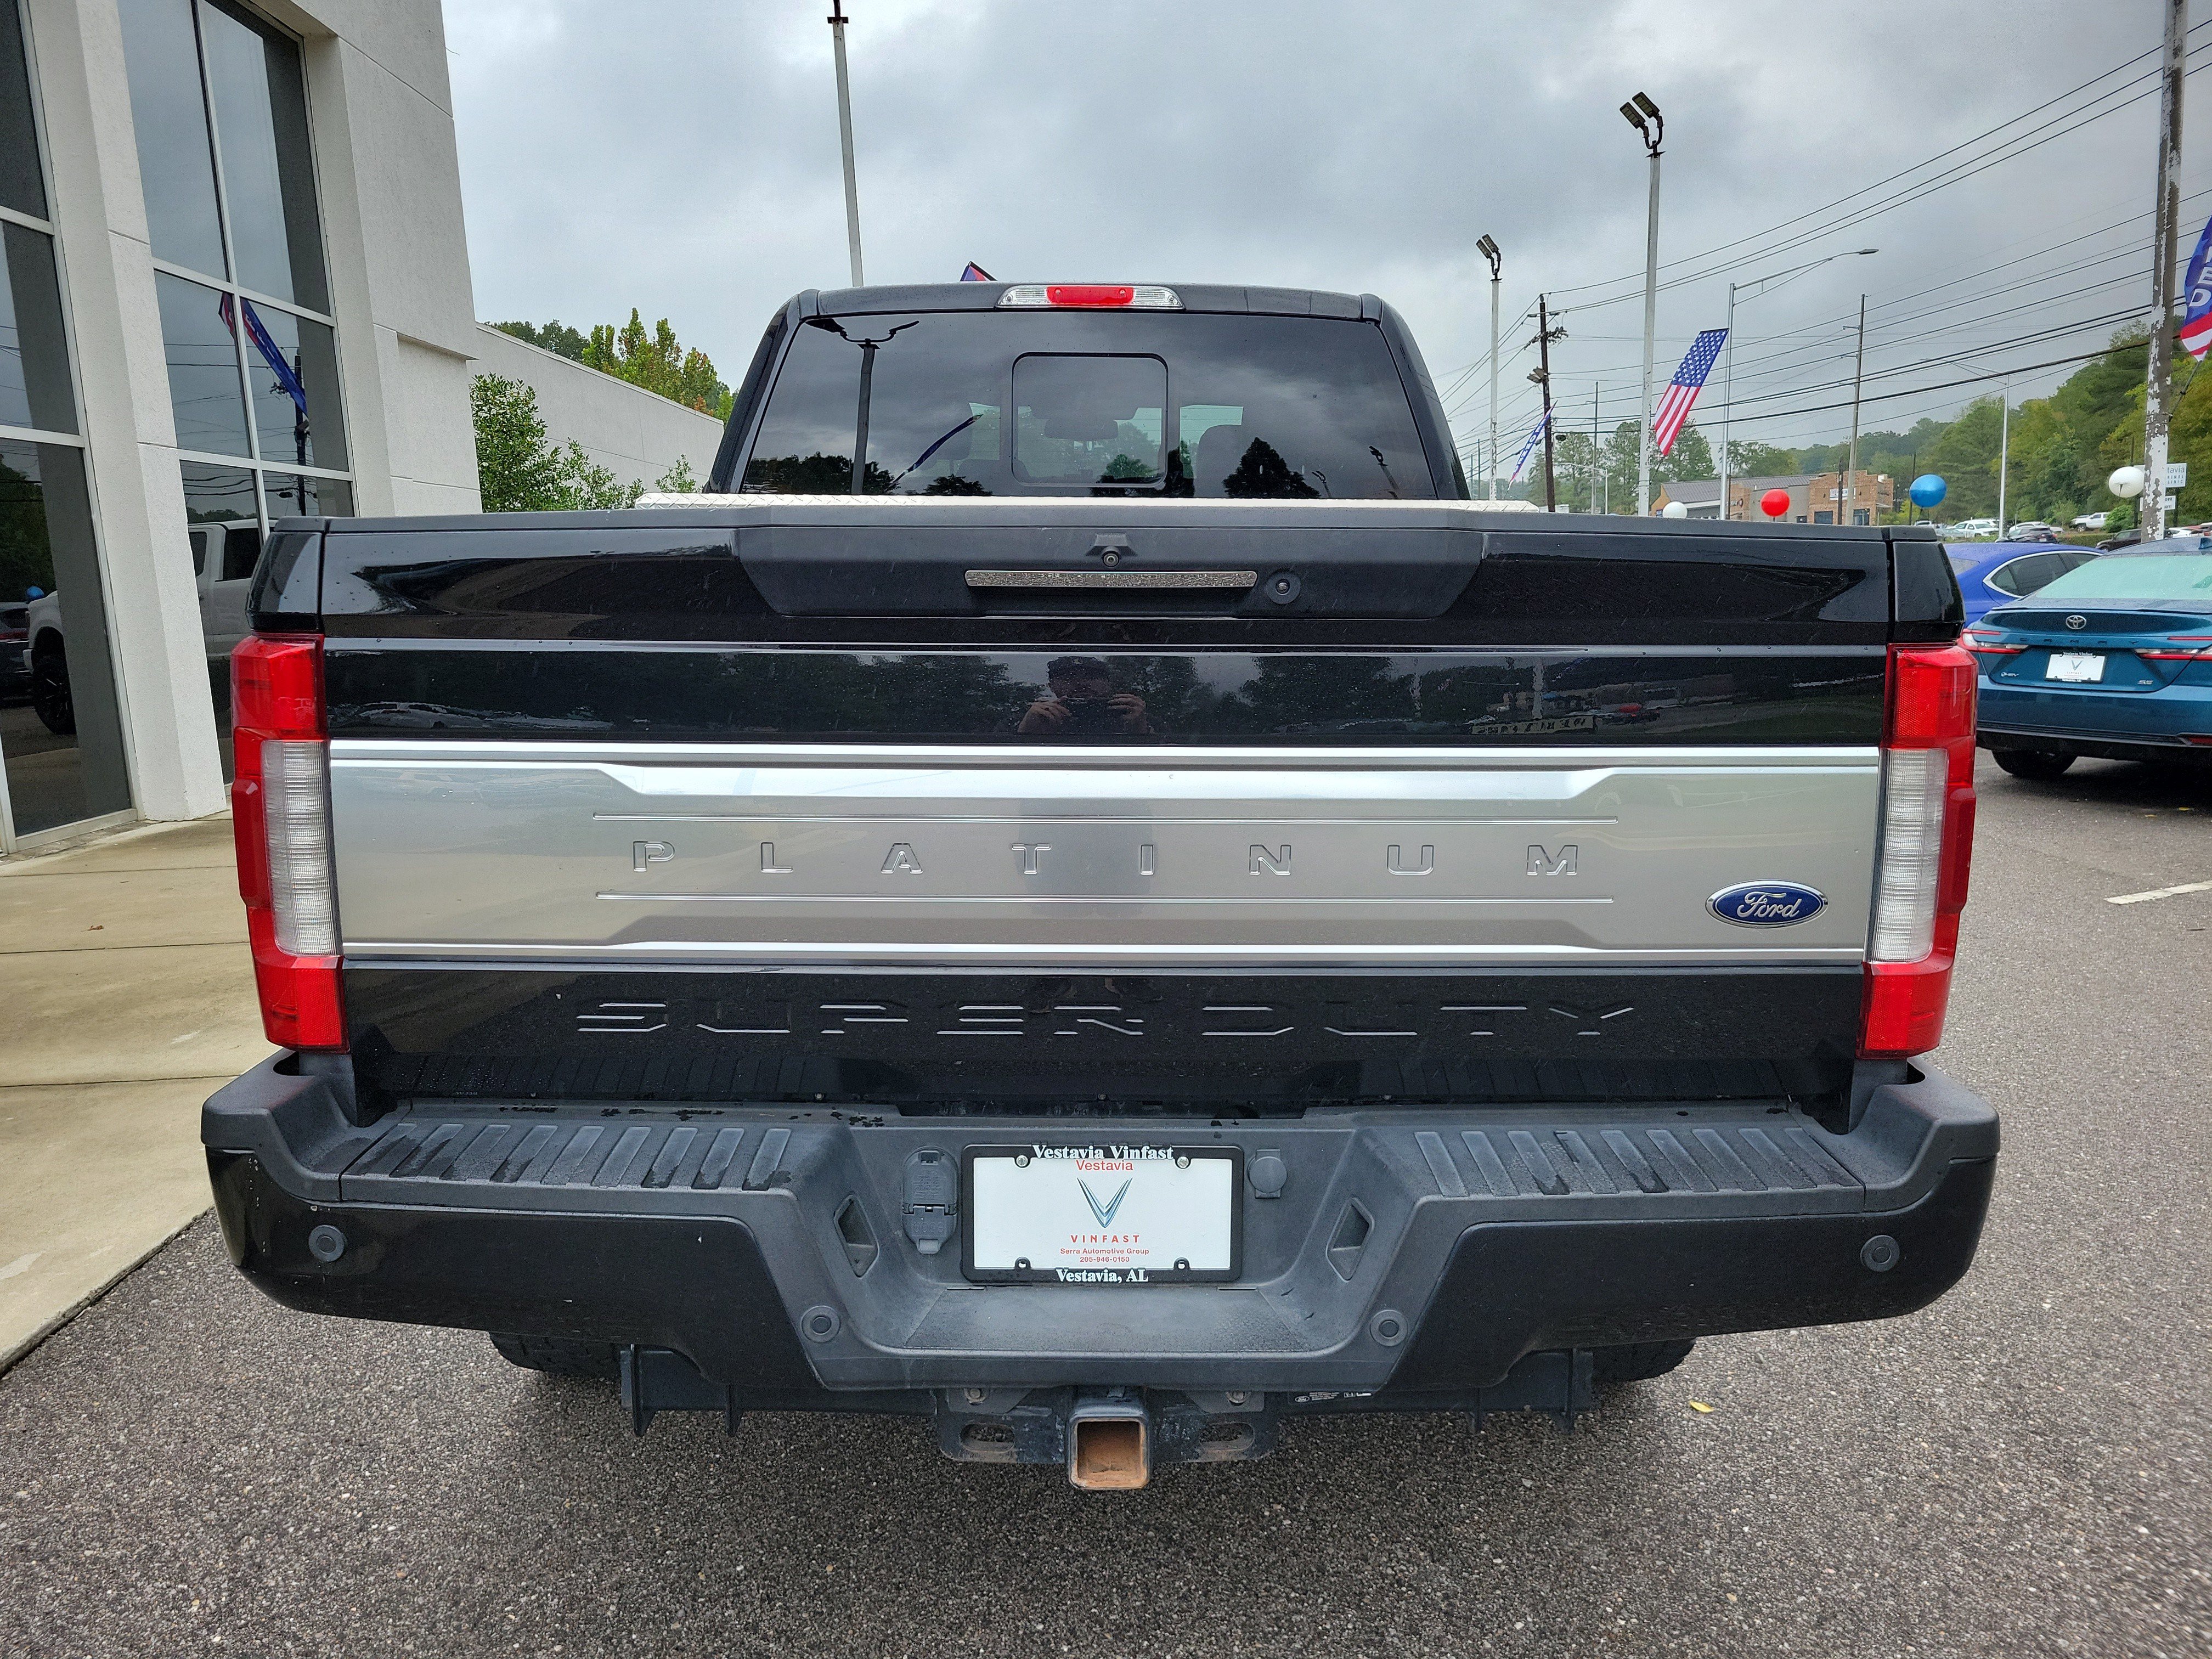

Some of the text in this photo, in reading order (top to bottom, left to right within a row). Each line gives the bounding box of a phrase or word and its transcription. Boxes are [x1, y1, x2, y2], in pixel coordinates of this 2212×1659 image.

[633, 840, 1578, 876] PLATINUM
[1736, 891, 1802, 917] Ford
[577, 1000, 1634, 1036] SUPER DUTY
[1032, 1144, 1174, 1160] Vestavia Vinfast
[1076, 1160, 1133, 1170] Vestavia
[1070, 1234, 1139, 1243] VINFAST
[1056, 1268, 1149, 1284] Vestavia, AL
